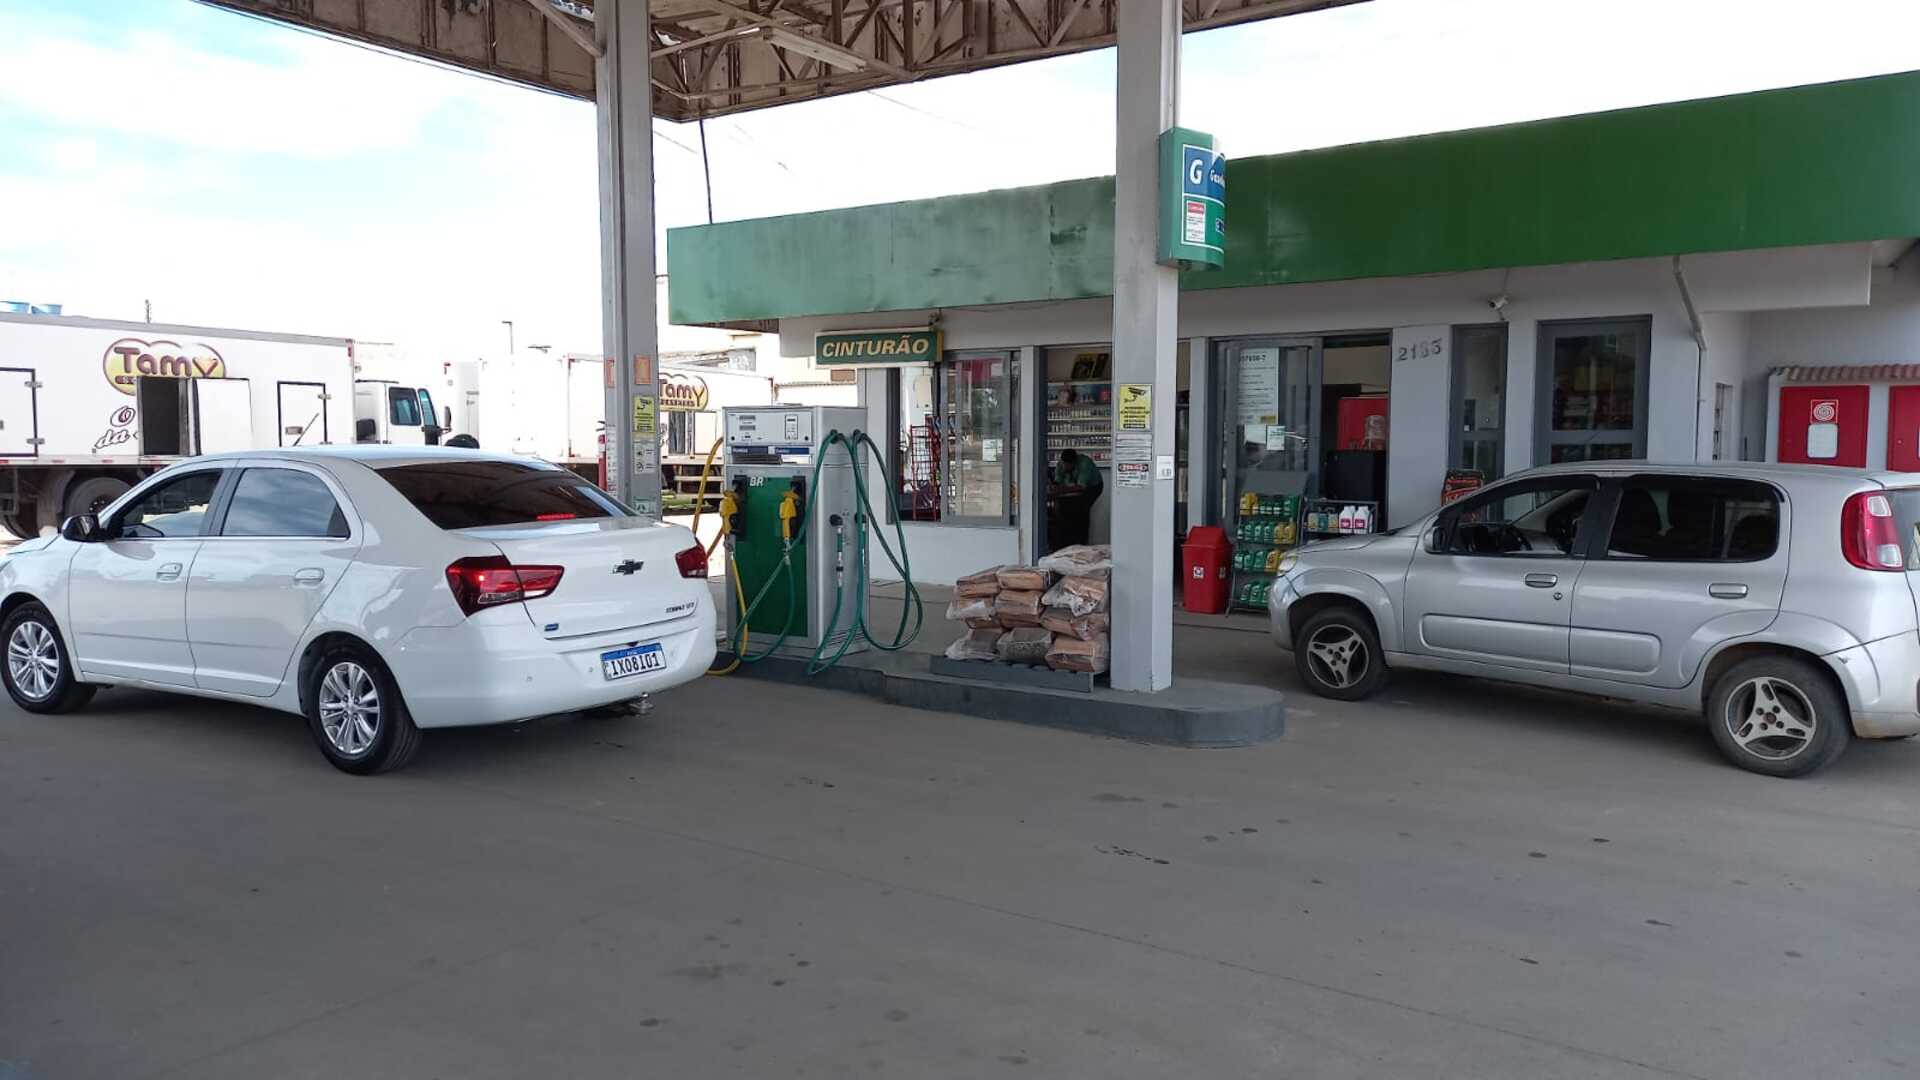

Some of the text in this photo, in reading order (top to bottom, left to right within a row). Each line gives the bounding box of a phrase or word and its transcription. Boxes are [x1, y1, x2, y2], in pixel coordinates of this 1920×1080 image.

[1190, 159, 1204, 185] G
[822, 335, 929, 358] CINTURÃO
[749, 476, 765, 487] BR
